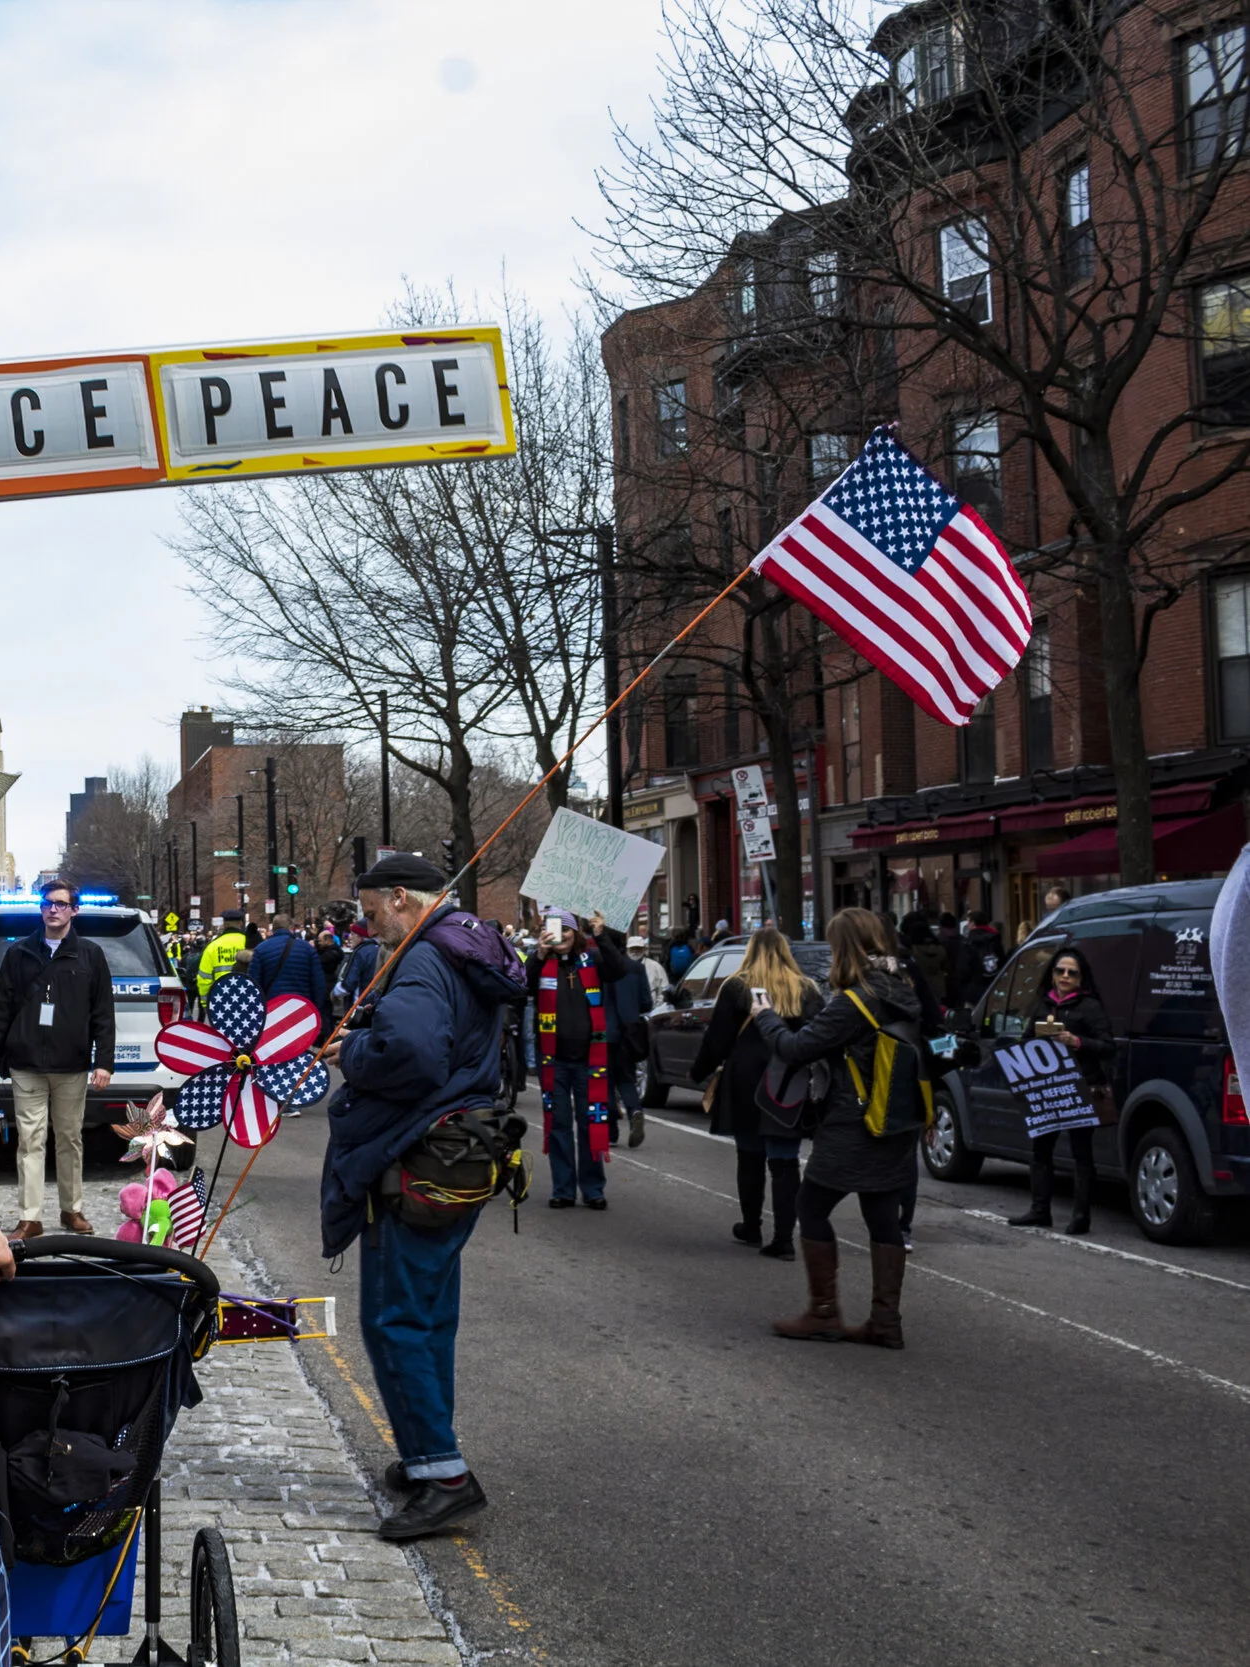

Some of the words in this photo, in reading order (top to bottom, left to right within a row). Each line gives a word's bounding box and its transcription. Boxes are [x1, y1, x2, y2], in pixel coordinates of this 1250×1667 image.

[198, 358, 466, 446] PEACE
[218, 955, 236, 963] Poli
[994, 1039, 1076, 1083] NO!
[1025, 1091, 1042, 1102] We
[1042, 1083, 1078, 1099] REFUSE
[1030, 1103, 1042, 1113] to
[1043, 1096, 1075, 1111] Accept
[1075, 1096, 1083, 1104] a
[1025, 1112, 1057, 1127] Fascist
